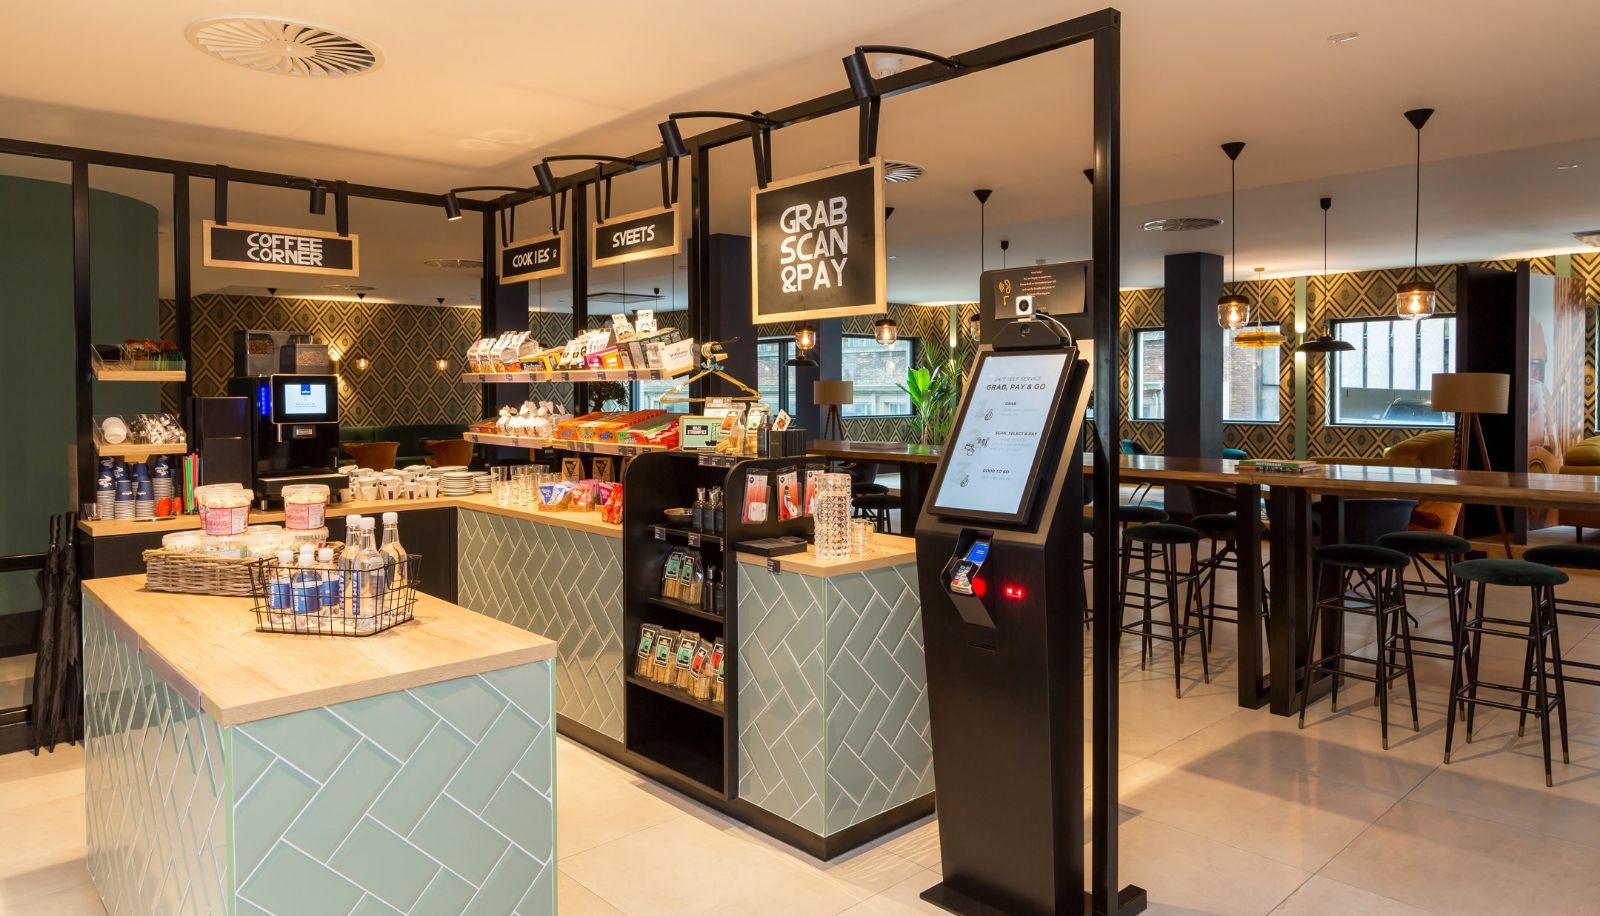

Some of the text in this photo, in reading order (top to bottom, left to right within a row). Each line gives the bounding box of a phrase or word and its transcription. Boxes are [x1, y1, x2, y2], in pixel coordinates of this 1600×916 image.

[780, 196, 847, 233] GRAB
[246, 232, 323, 253] COFFEE
[780, 226, 848, 264] SCAN
[246, 246, 323, 266] CORNER
[512, 247, 550, 268] COOKIES
[781, 257, 848, 294] &PAY
[986, 383, 1008, 391] GRAB,
